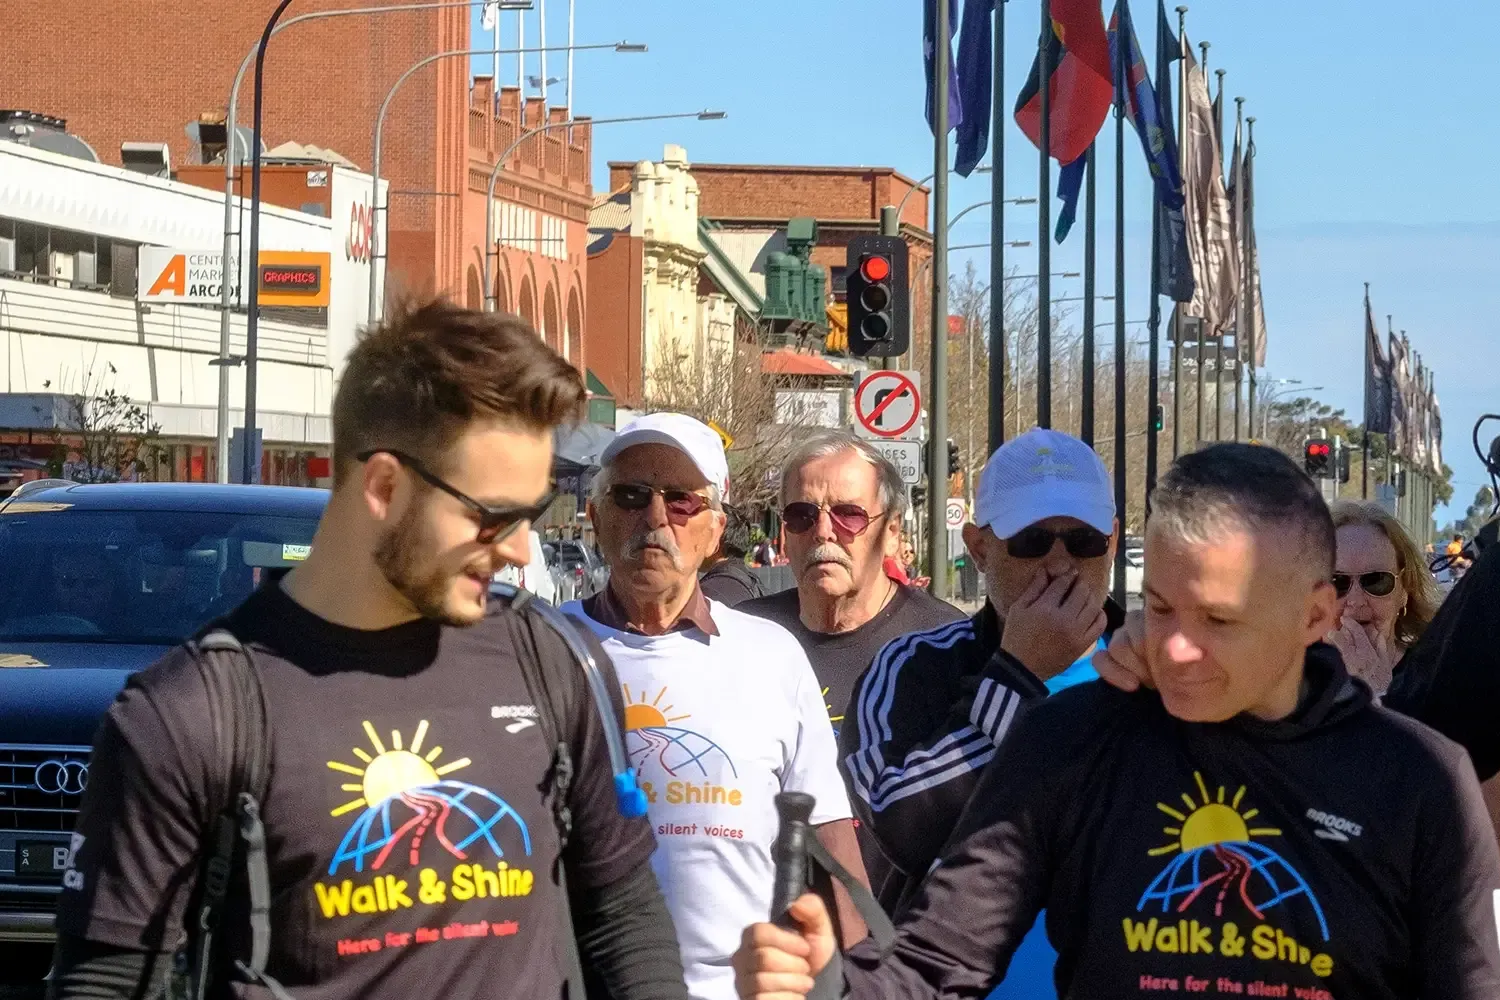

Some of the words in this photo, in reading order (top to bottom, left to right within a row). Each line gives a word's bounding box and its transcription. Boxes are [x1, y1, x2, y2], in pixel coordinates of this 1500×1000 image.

[264, 271, 316, 284] GRAPHICS
[947, 509, 961, 519] 50
[491, 705, 540, 719] BROOK
[666, 781, 743, 806] Shine
[658, 822, 698, 836] silent
[704, 824, 744, 839] voices
[1306, 808, 1363, 837] BROOKS
[314, 874, 413, 918] Walk
[418, 867, 446, 905] &
[451, 861, 534, 900] Shine
[337, 938, 382, 956] Here
[384, 931, 412, 947] for
[415, 927, 440, 943] the
[443, 919, 489, 940] silent
[1122, 917, 1214, 954] Walk
[1219, 922, 1246, 957] &
[1139, 975, 1179, 991] Here
[1184, 975, 1210, 992] for
[1216, 977, 1243, 994] the
[1247, 980, 1288, 997] silent
